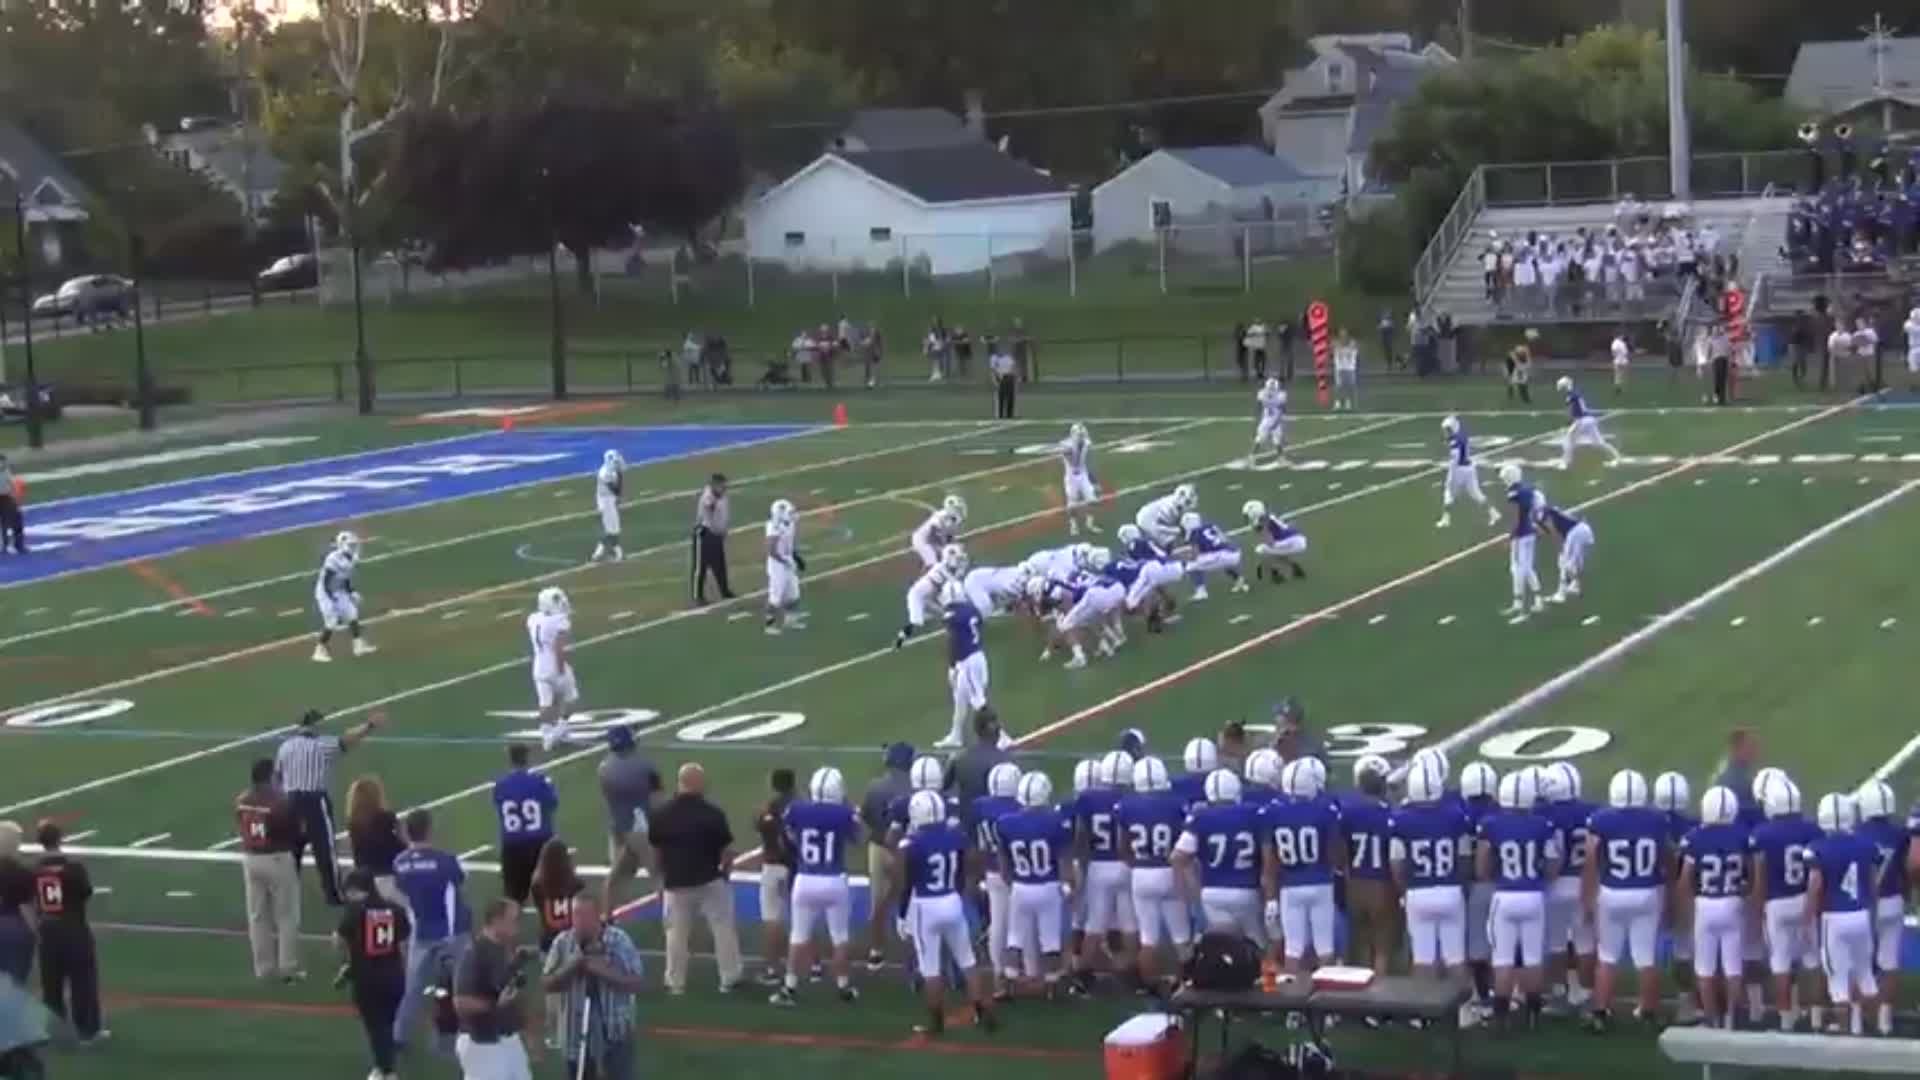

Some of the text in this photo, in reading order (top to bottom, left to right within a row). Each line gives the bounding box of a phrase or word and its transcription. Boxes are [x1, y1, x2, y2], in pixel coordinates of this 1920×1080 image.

[502, 800, 542, 831] 69
[800, 828, 835, 864] 61
[1010, 839, 1051, 877] 60
[1128, 823, 1171, 860] 28
[1207, 832, 1254, 869] 72
[1274, 826, 1320, 864] 80
[1351, 832, 1381, 869] 71
[1411, 838, 1454, 877] 58
[1500, 841, 1537, 878] 81
[1607, 838, 1657, 880] 50
[926, 851, 958, 891] 31
[1700, 854, 1744, 894] 22
[1840, 861, 1858, 900] 4
